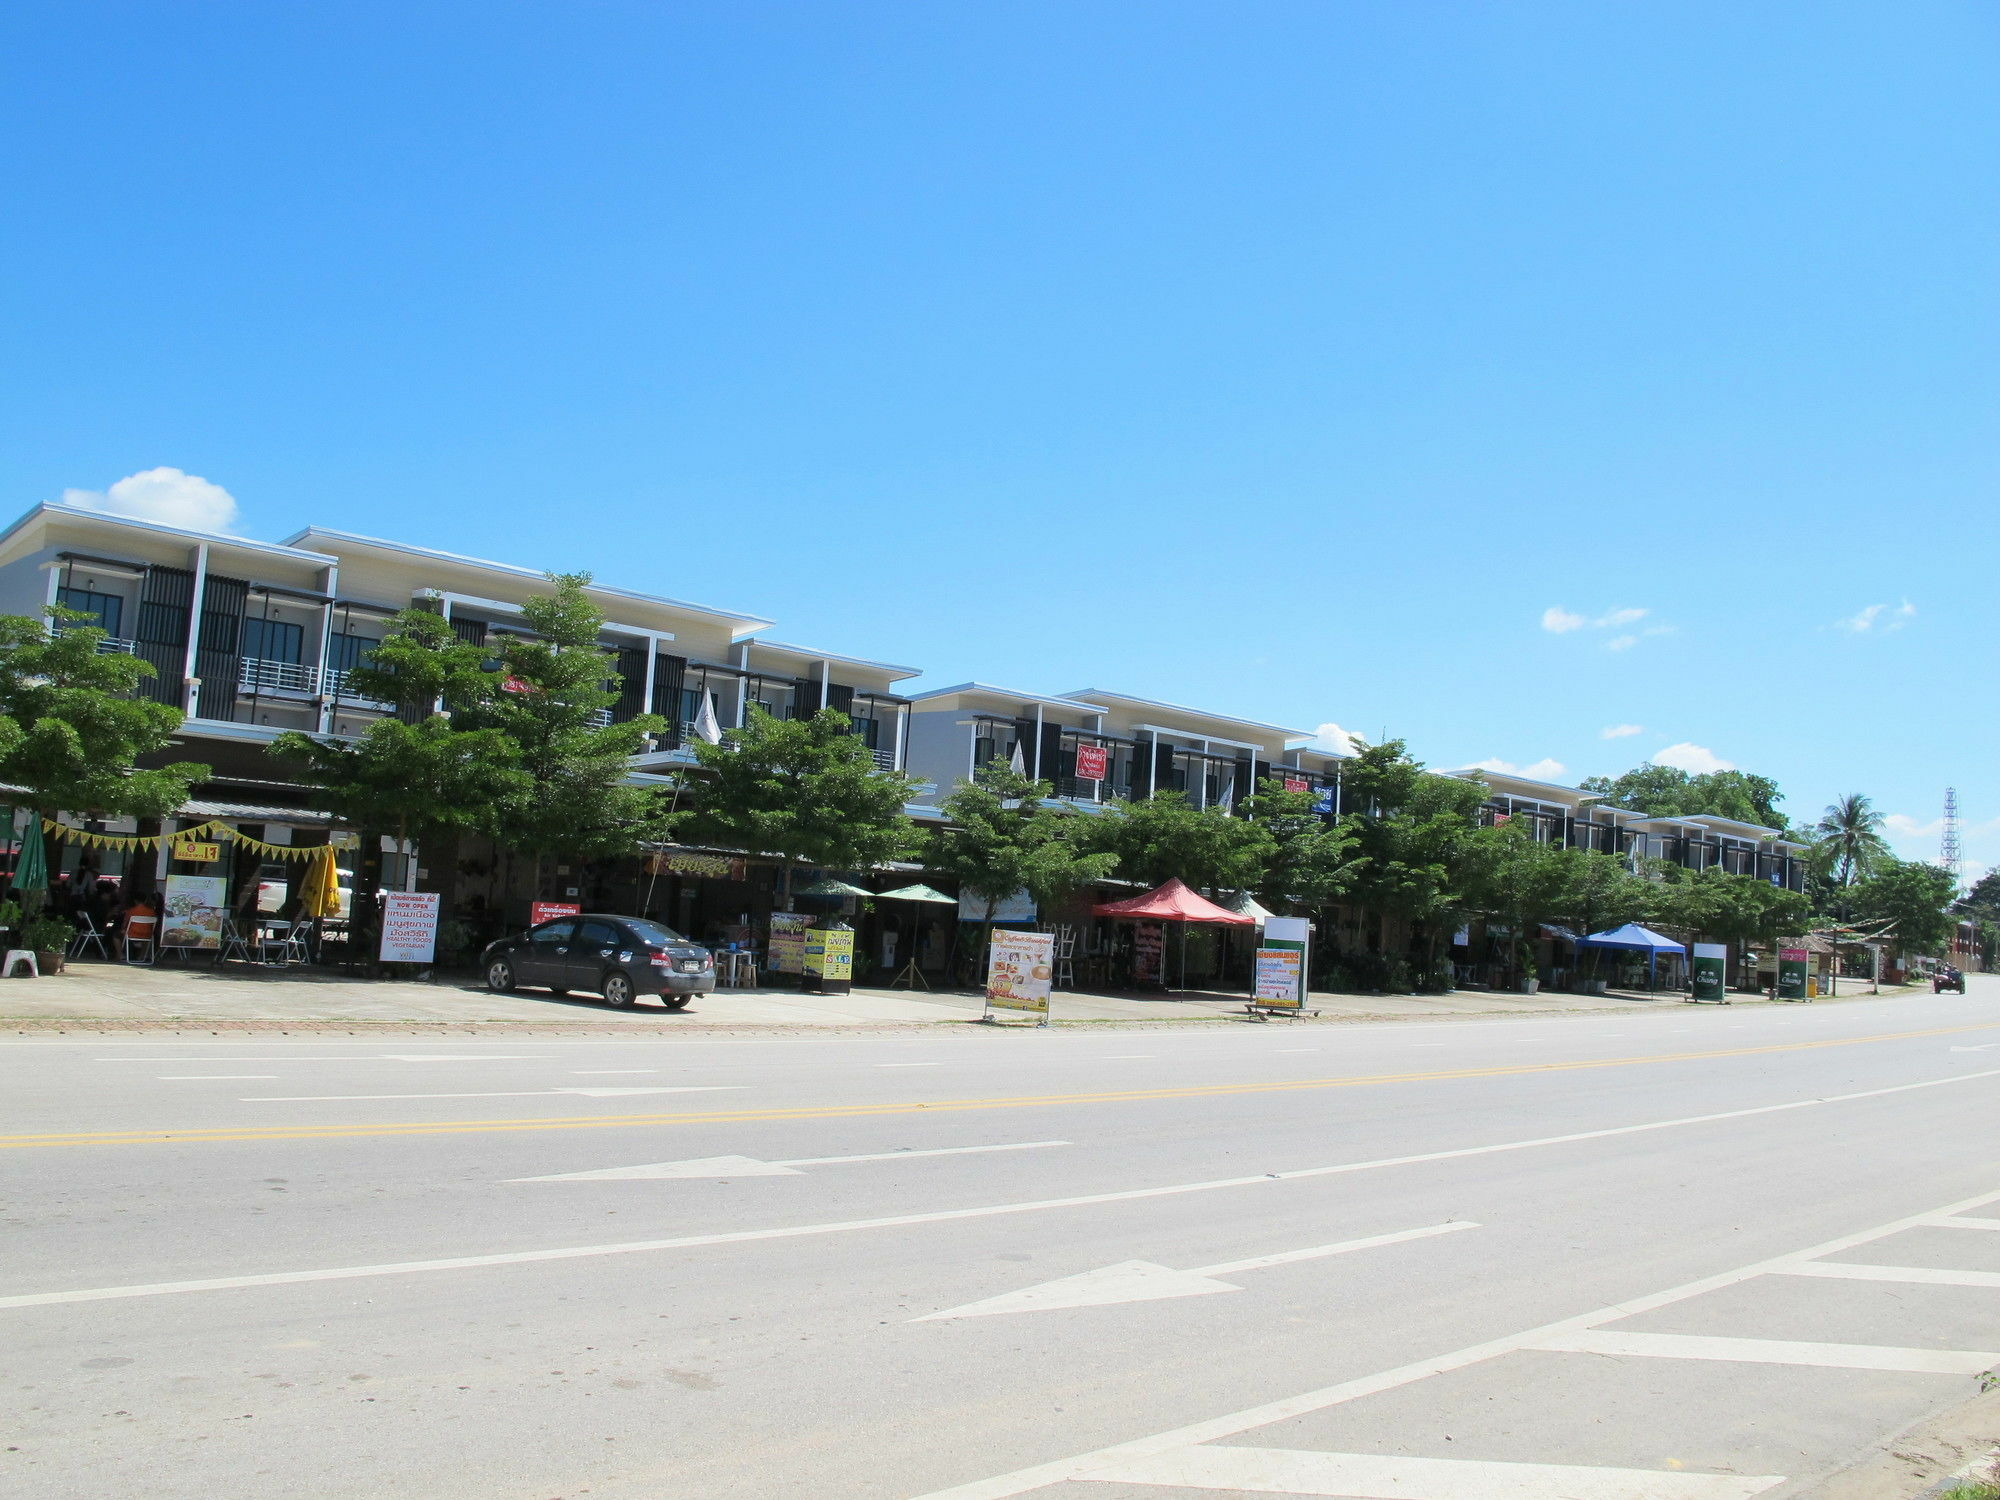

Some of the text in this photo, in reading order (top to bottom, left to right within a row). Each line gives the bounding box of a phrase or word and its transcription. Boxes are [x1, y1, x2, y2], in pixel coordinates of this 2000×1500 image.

[826, 954, 850, 964] SALE
[1697, 976, 1718, 985] Chang
[1782, 977, 1801, 985] Chang
